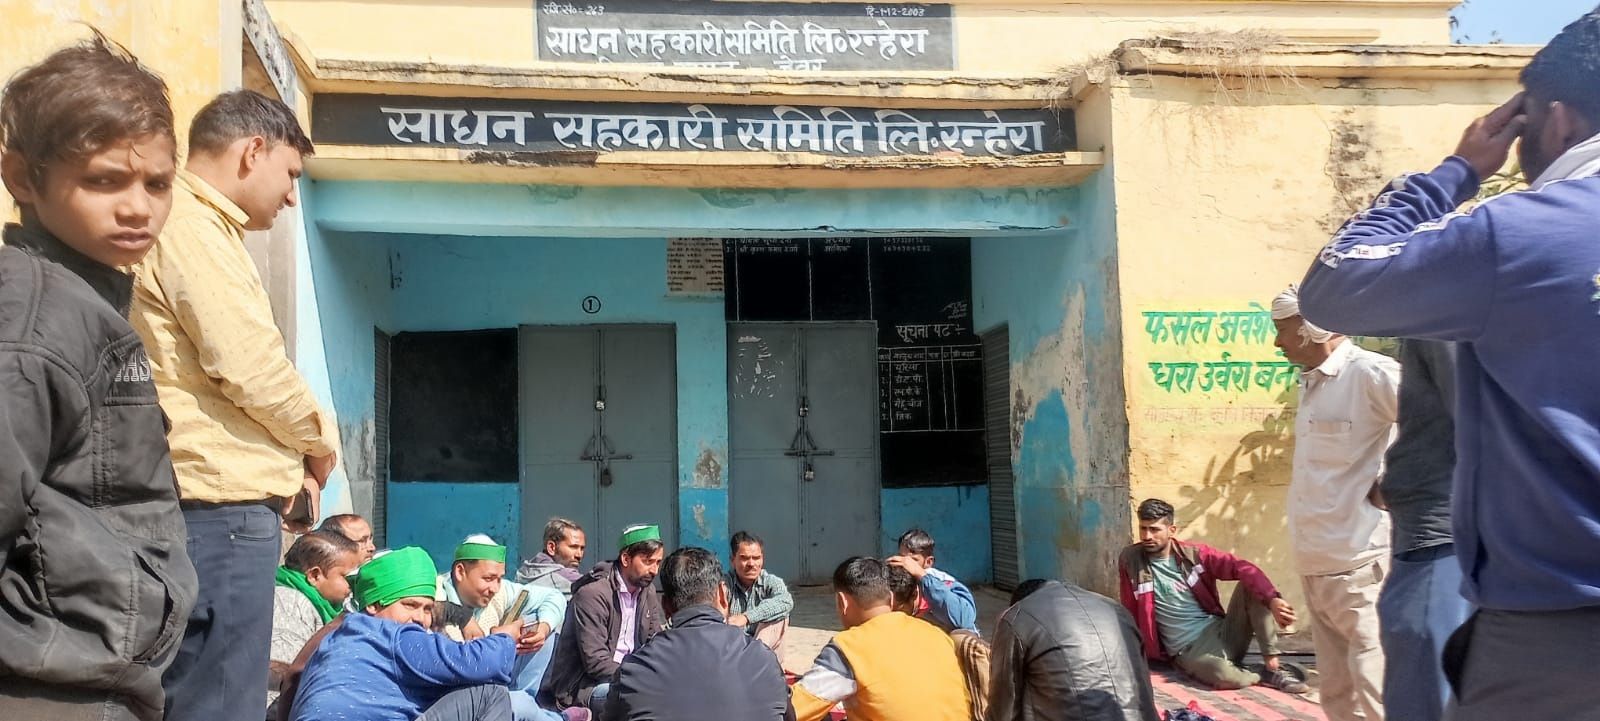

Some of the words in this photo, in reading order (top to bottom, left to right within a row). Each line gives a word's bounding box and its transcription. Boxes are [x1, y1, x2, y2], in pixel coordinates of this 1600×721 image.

[545, 26, 620, 56] साधन
[624, 22, 723, 59] सहकारी
[722, 20, 799, 57] समिति
[380, 106, 534, 147] साधन
[544, 104, 728, 151] सहकारी
[736, 105, 872, 154] समिति
[586, 300, 593, 310] 1
[896, 324, 929, 344] सूचना
[1142, 311, 1217, 345] फसल
[1199, 351, 1253, 392] उर्वरा
